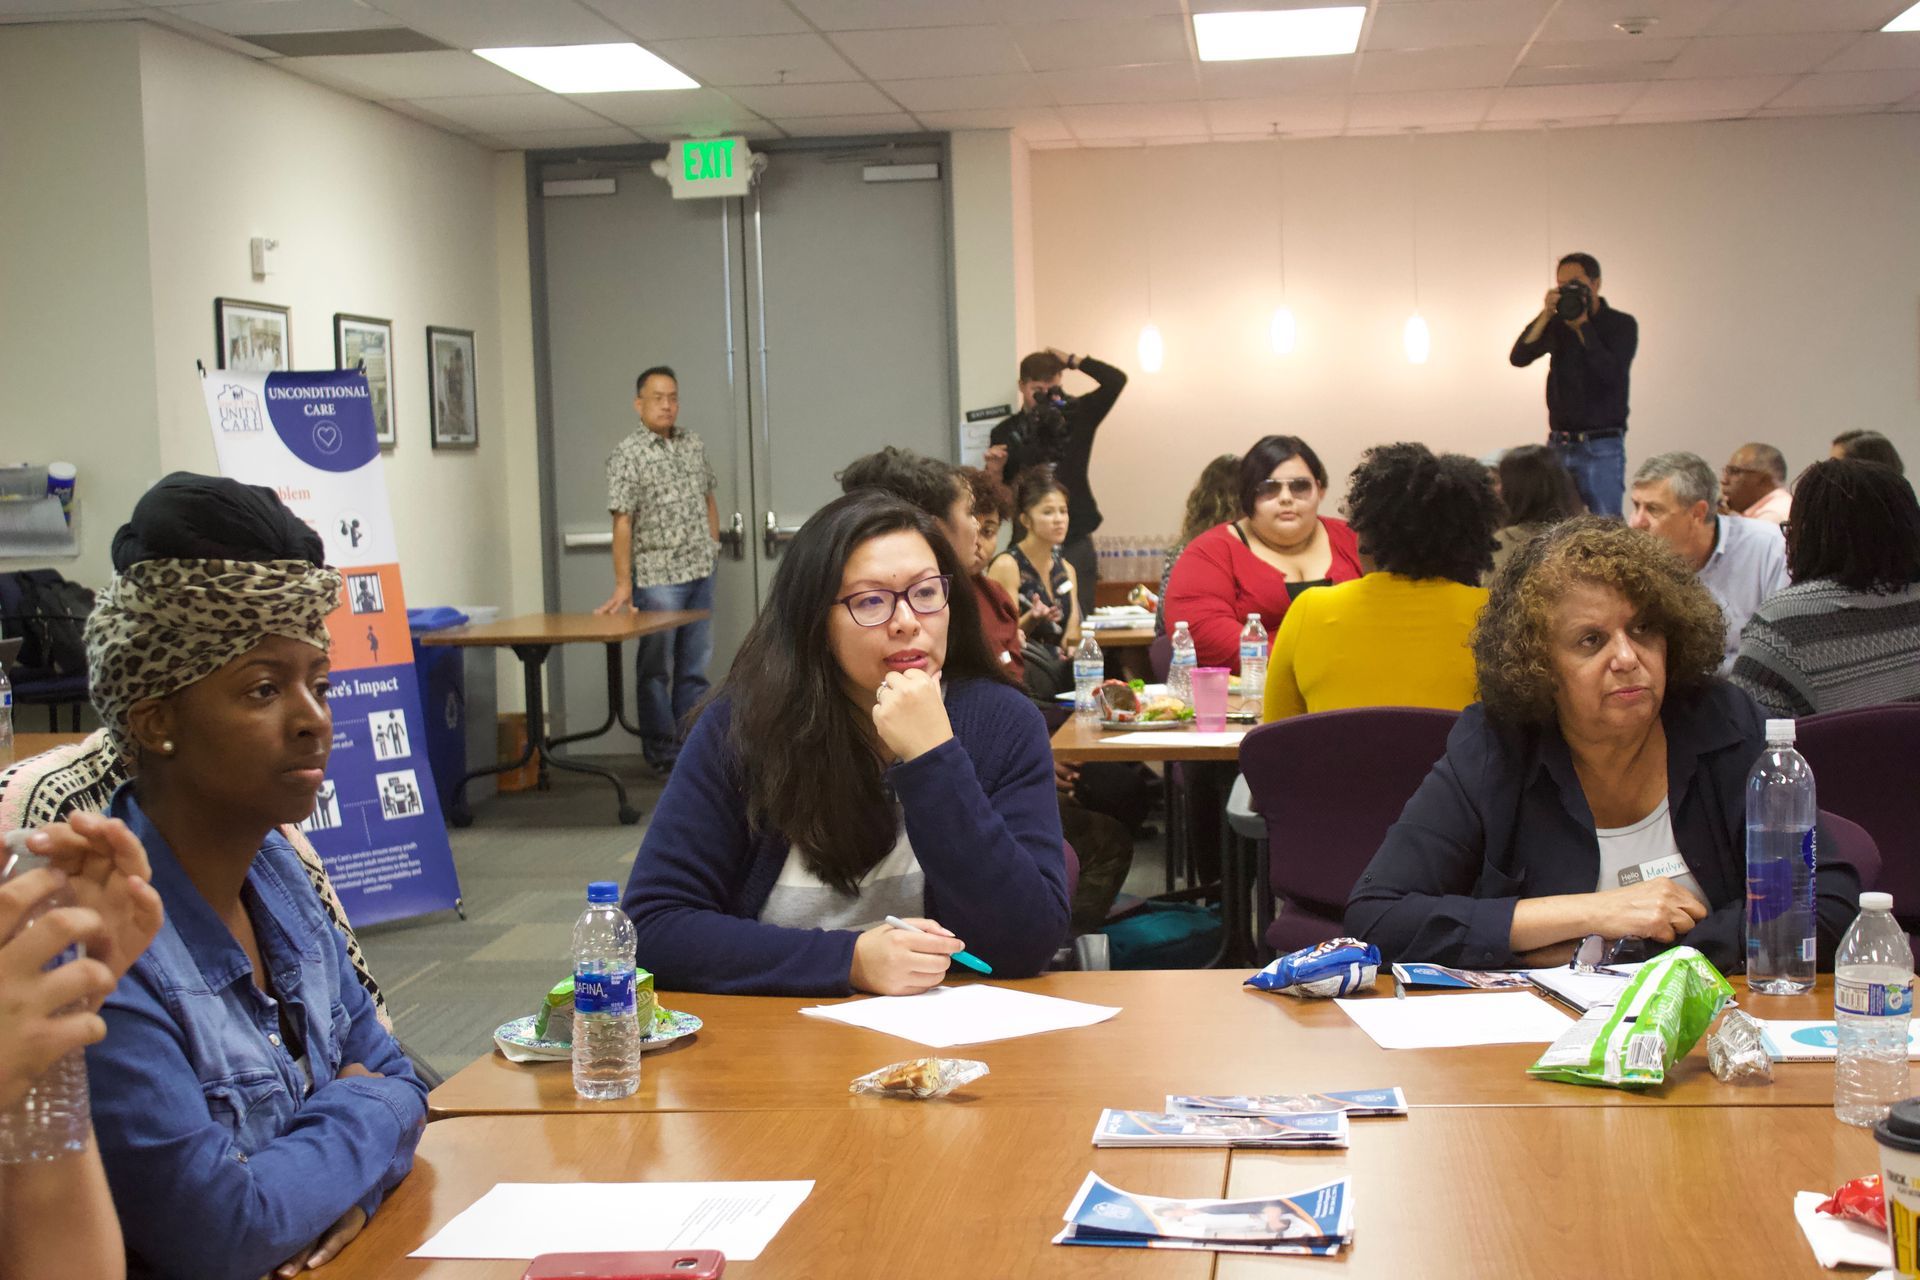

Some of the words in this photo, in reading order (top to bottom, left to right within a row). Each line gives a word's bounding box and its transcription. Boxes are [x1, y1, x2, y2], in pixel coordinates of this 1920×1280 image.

[684, 140, 735, 180] EXIT
[268, 386, 368, 399] UNCONDITIONAL
[219, 407, 258, 418] UNITY
[304, 404, 336, 416] CARE
[221, 418, 260, 431] CARE
[278, 486, 311, 500] blem
[326, 680, 352, 698] are's
[354, 677, 399, 698] Impact
[1621, 872, 1639, 881] Hello
[1646, 862, 1684, 878] Marilyn
